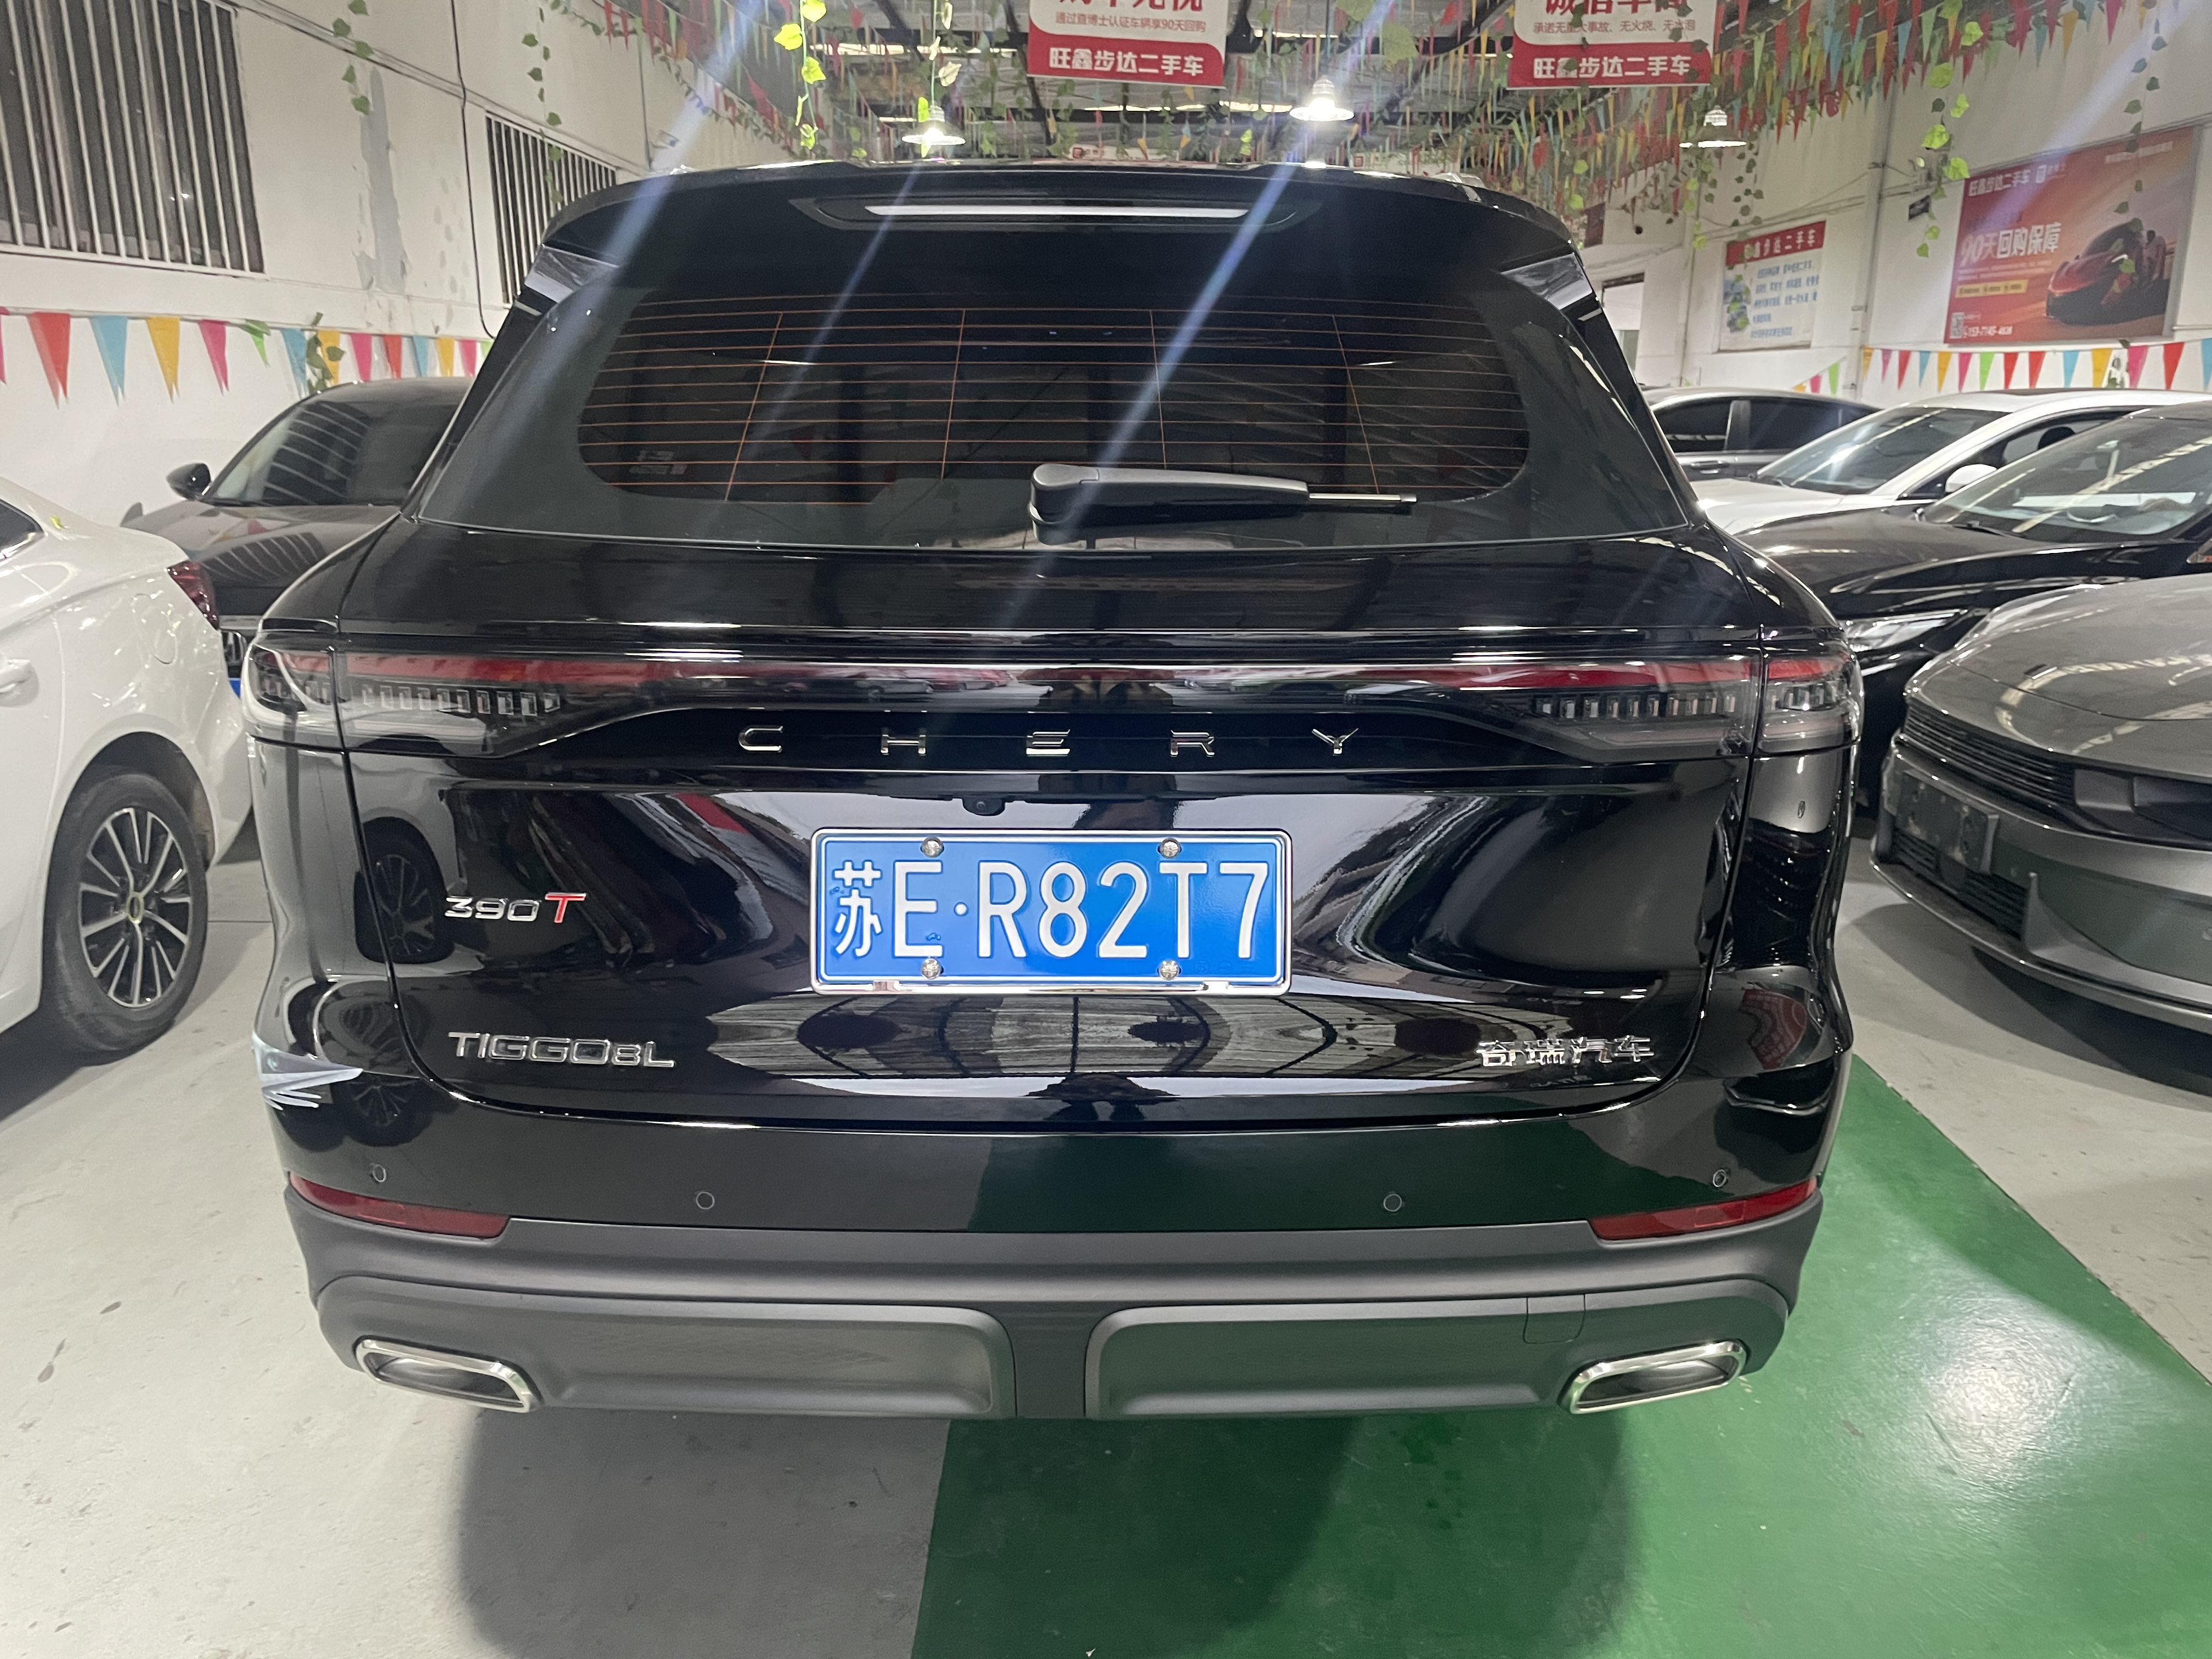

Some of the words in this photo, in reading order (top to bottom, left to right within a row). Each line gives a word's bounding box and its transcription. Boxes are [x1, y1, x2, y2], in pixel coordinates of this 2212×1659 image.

[1049, 47, 1204, 76] 旺鑫步达二手车
[1534, 55, 1691, 78] 旺鑫步达二手车
[738, 725, 1358, 756] CHERY
[444, 892, 588, 924] 390T
[834, 859, 1268, 958] 苏E·R82T7
[1476, 1035, 1655, 1067] 奇瑞汽车
